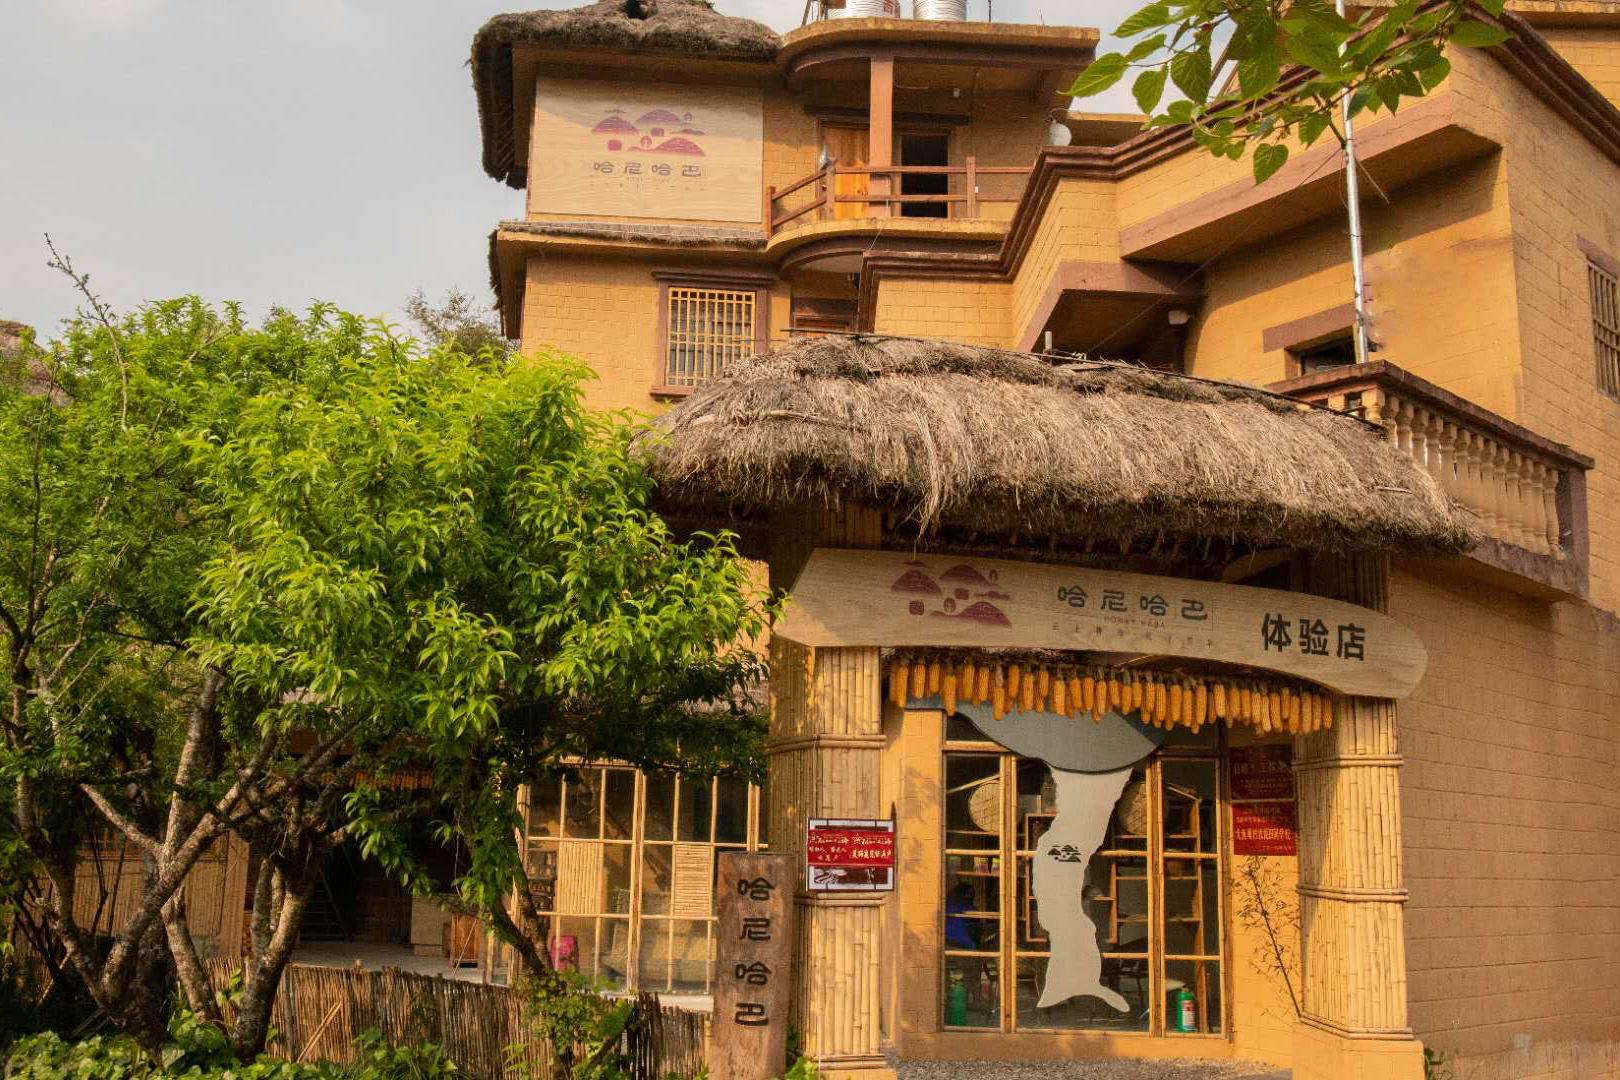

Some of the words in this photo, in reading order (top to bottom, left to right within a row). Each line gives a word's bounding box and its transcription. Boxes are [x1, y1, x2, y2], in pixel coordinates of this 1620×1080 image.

[593, 161, 702, 177] 哈尼哈巴
[1057, 585, 1208, 620] 哈尼哈巴
[1261, 613, 1366, 661] 体验店
[735, 877, 775, 1026] 哈尼哈巴
